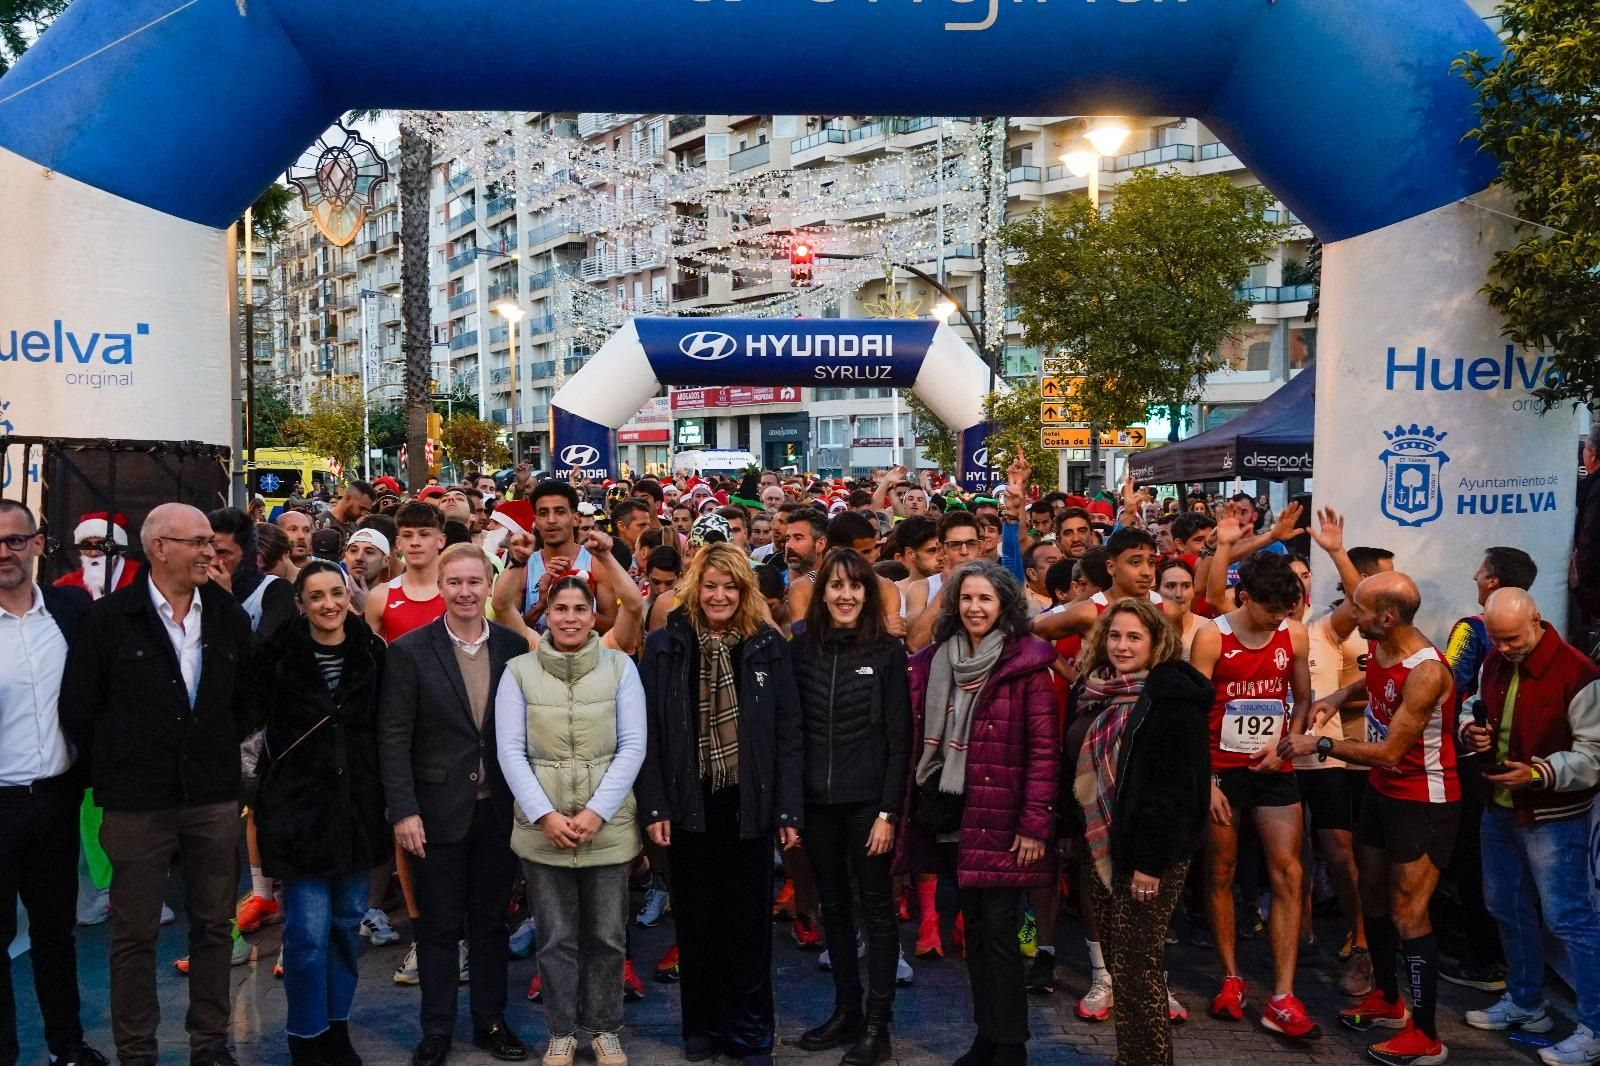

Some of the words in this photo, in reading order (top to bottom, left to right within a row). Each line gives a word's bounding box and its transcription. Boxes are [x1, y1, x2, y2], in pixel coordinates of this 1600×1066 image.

[0, 319, 133, 365] uelva
[746, 334, 893, 357] HYUNDAI
[65, 370, 134, 389] original
[814, 365, 892, 379] SYRLUZ
[1044, 438, 1070, 446] Costa
[1073, 438, 1084, 446] de
[1099, 438, 1115, 446] Luz
[1243, 452, 1313, 472] alssport
[555, 469, 607, 479] HYDAI
[1459, 477, 1546, 493] Ayuntamiento
[1547, 474, 1558, 485] de
[1456, 491, 1557, 515] HUELVA
[1234, 716, 1274, 736] 192
